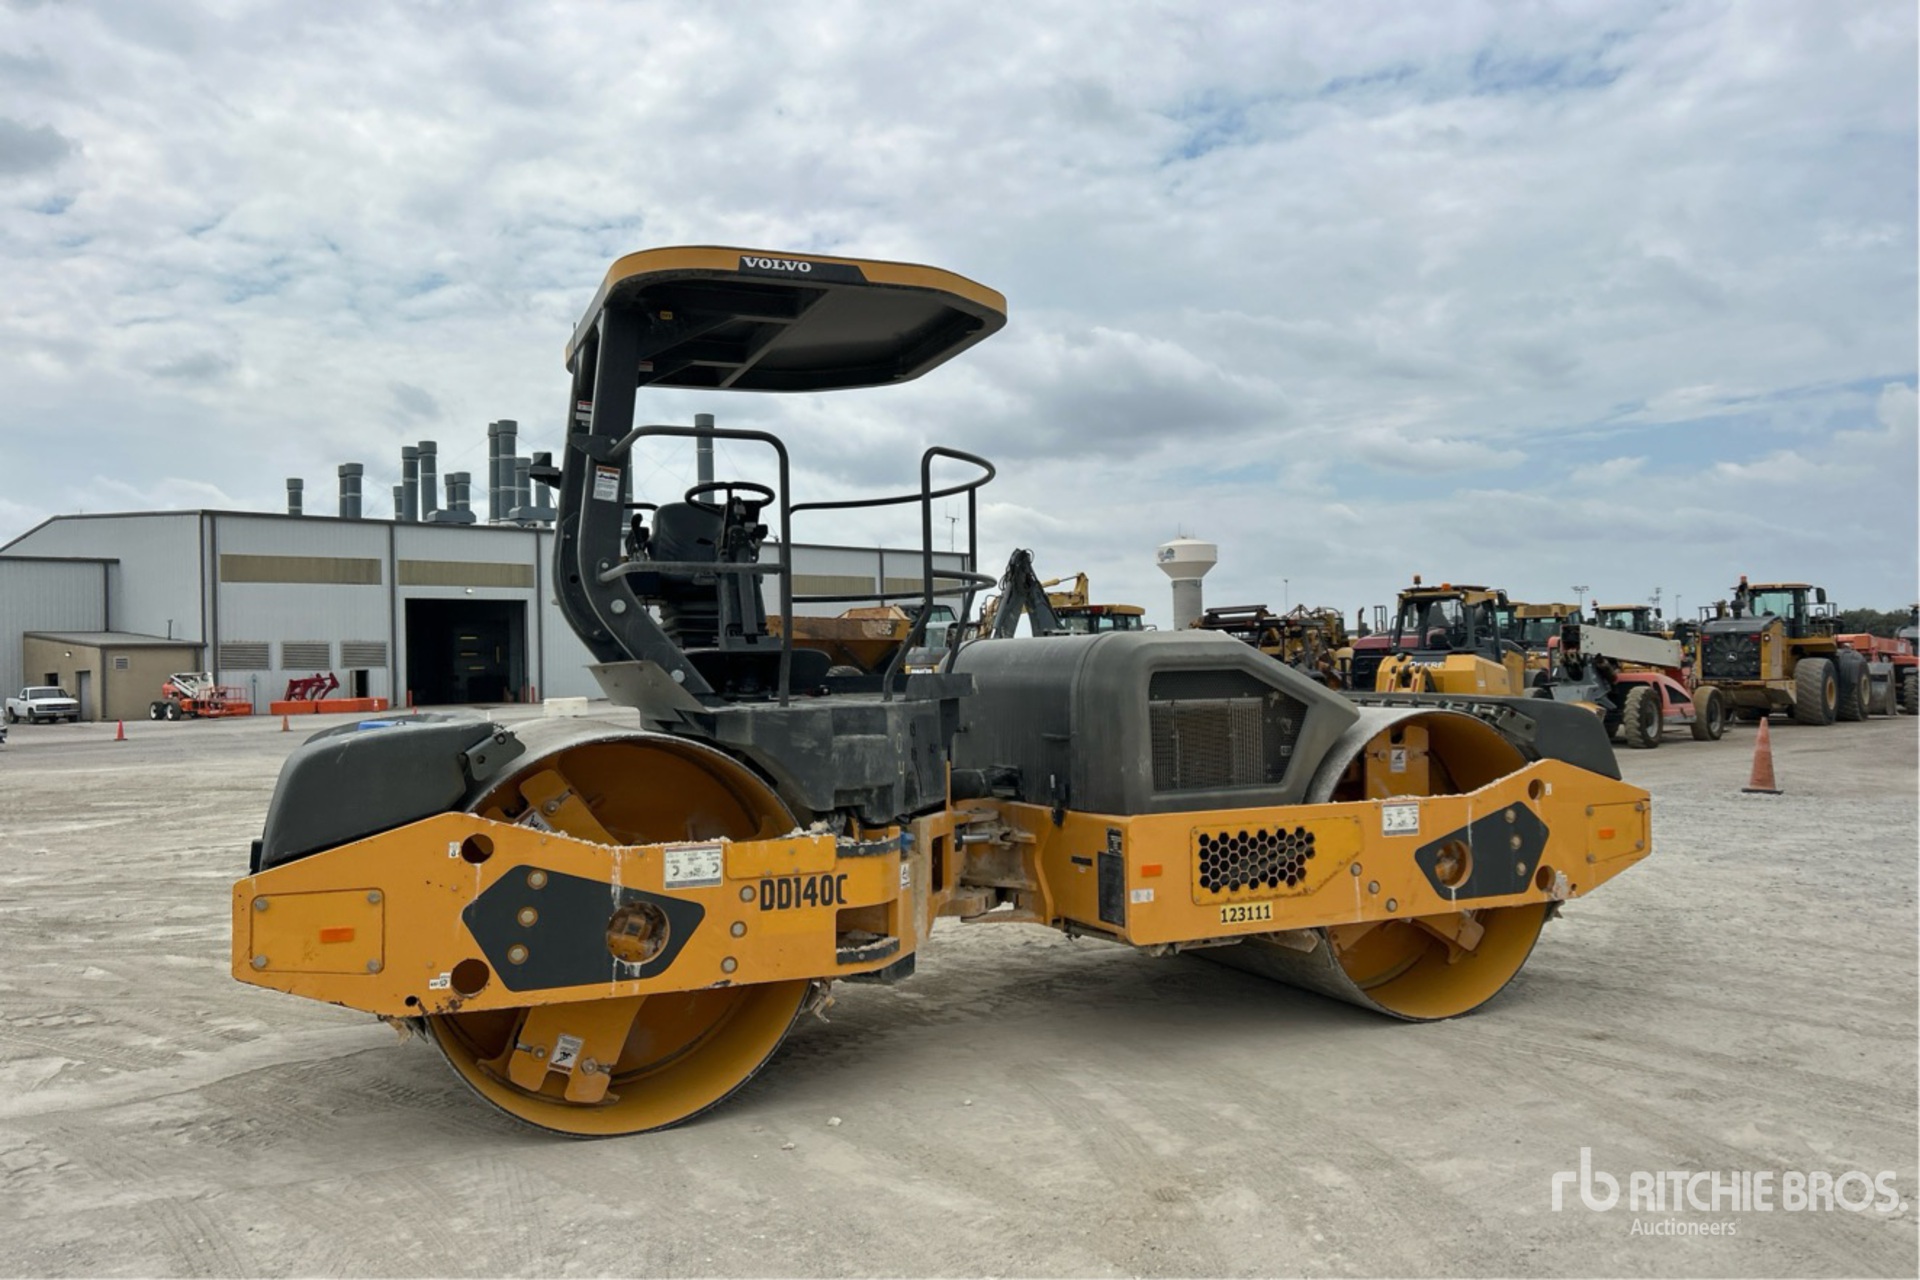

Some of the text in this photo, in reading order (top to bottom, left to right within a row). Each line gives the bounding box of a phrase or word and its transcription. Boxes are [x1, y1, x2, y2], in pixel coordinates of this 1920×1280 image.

[742, 256, 811, 272] VOLVO
[760, 874, 848, 911] DD140C
[1221, 904, 1271, 923] 123111
